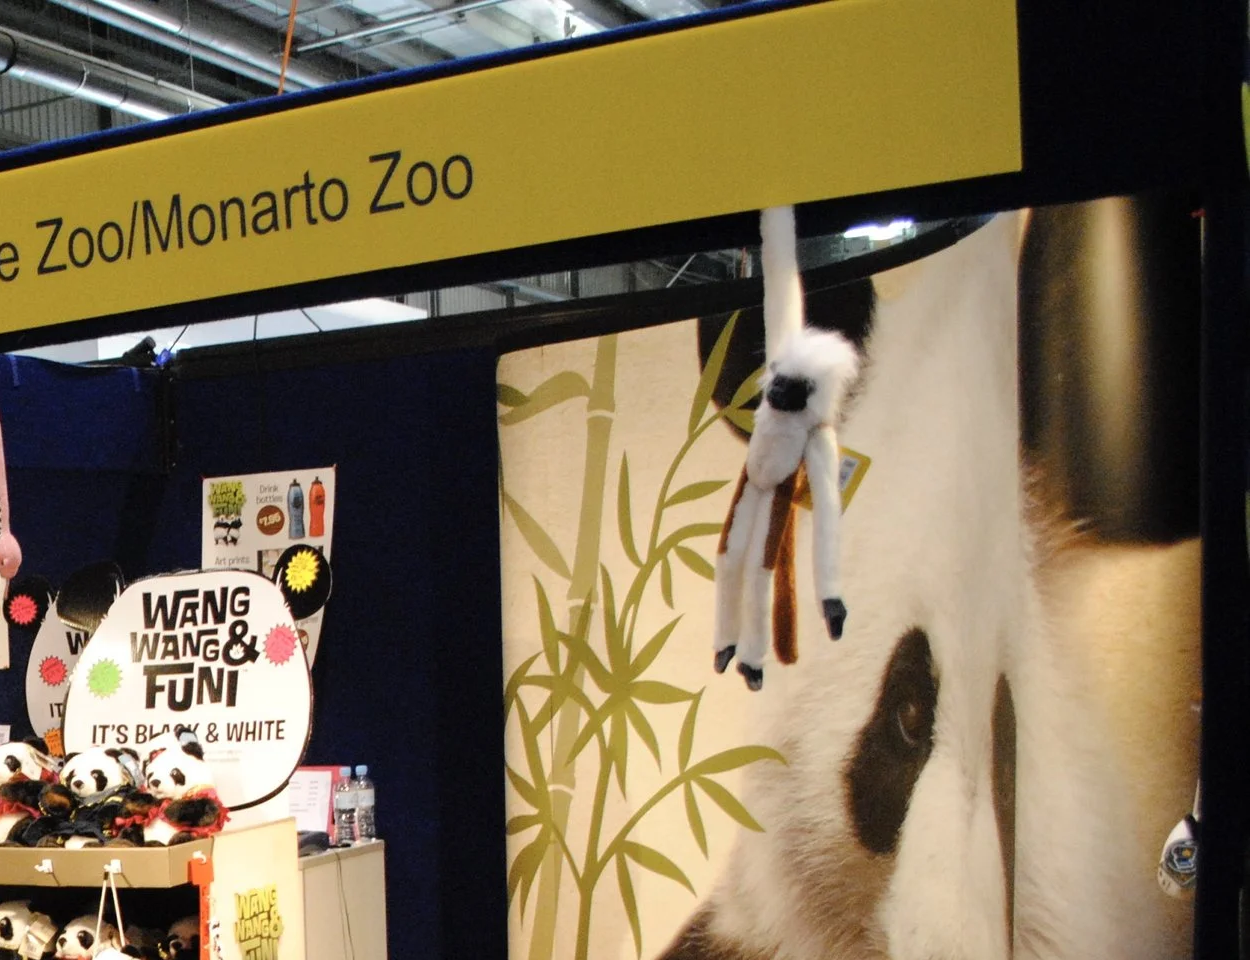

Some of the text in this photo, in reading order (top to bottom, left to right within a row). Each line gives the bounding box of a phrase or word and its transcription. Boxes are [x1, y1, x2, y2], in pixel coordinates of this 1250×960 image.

[36, 170, 350, 276] Zoo/Monarto
[368, 149, 474, 214] Zoo
[141, 586, 251, 632] WANG
[129, 628, 219, 664] WANG
[222, 619, 261, 667] &
[143, 662, 240, 712] FUNI
[92, 724, 129, 745] IT'S
[205, 722, 219, 743] &
[226, 719, 286, 742] WHITE
[234, 883, 278, 921] WANG
[234, 911, 271, 943] WANG
